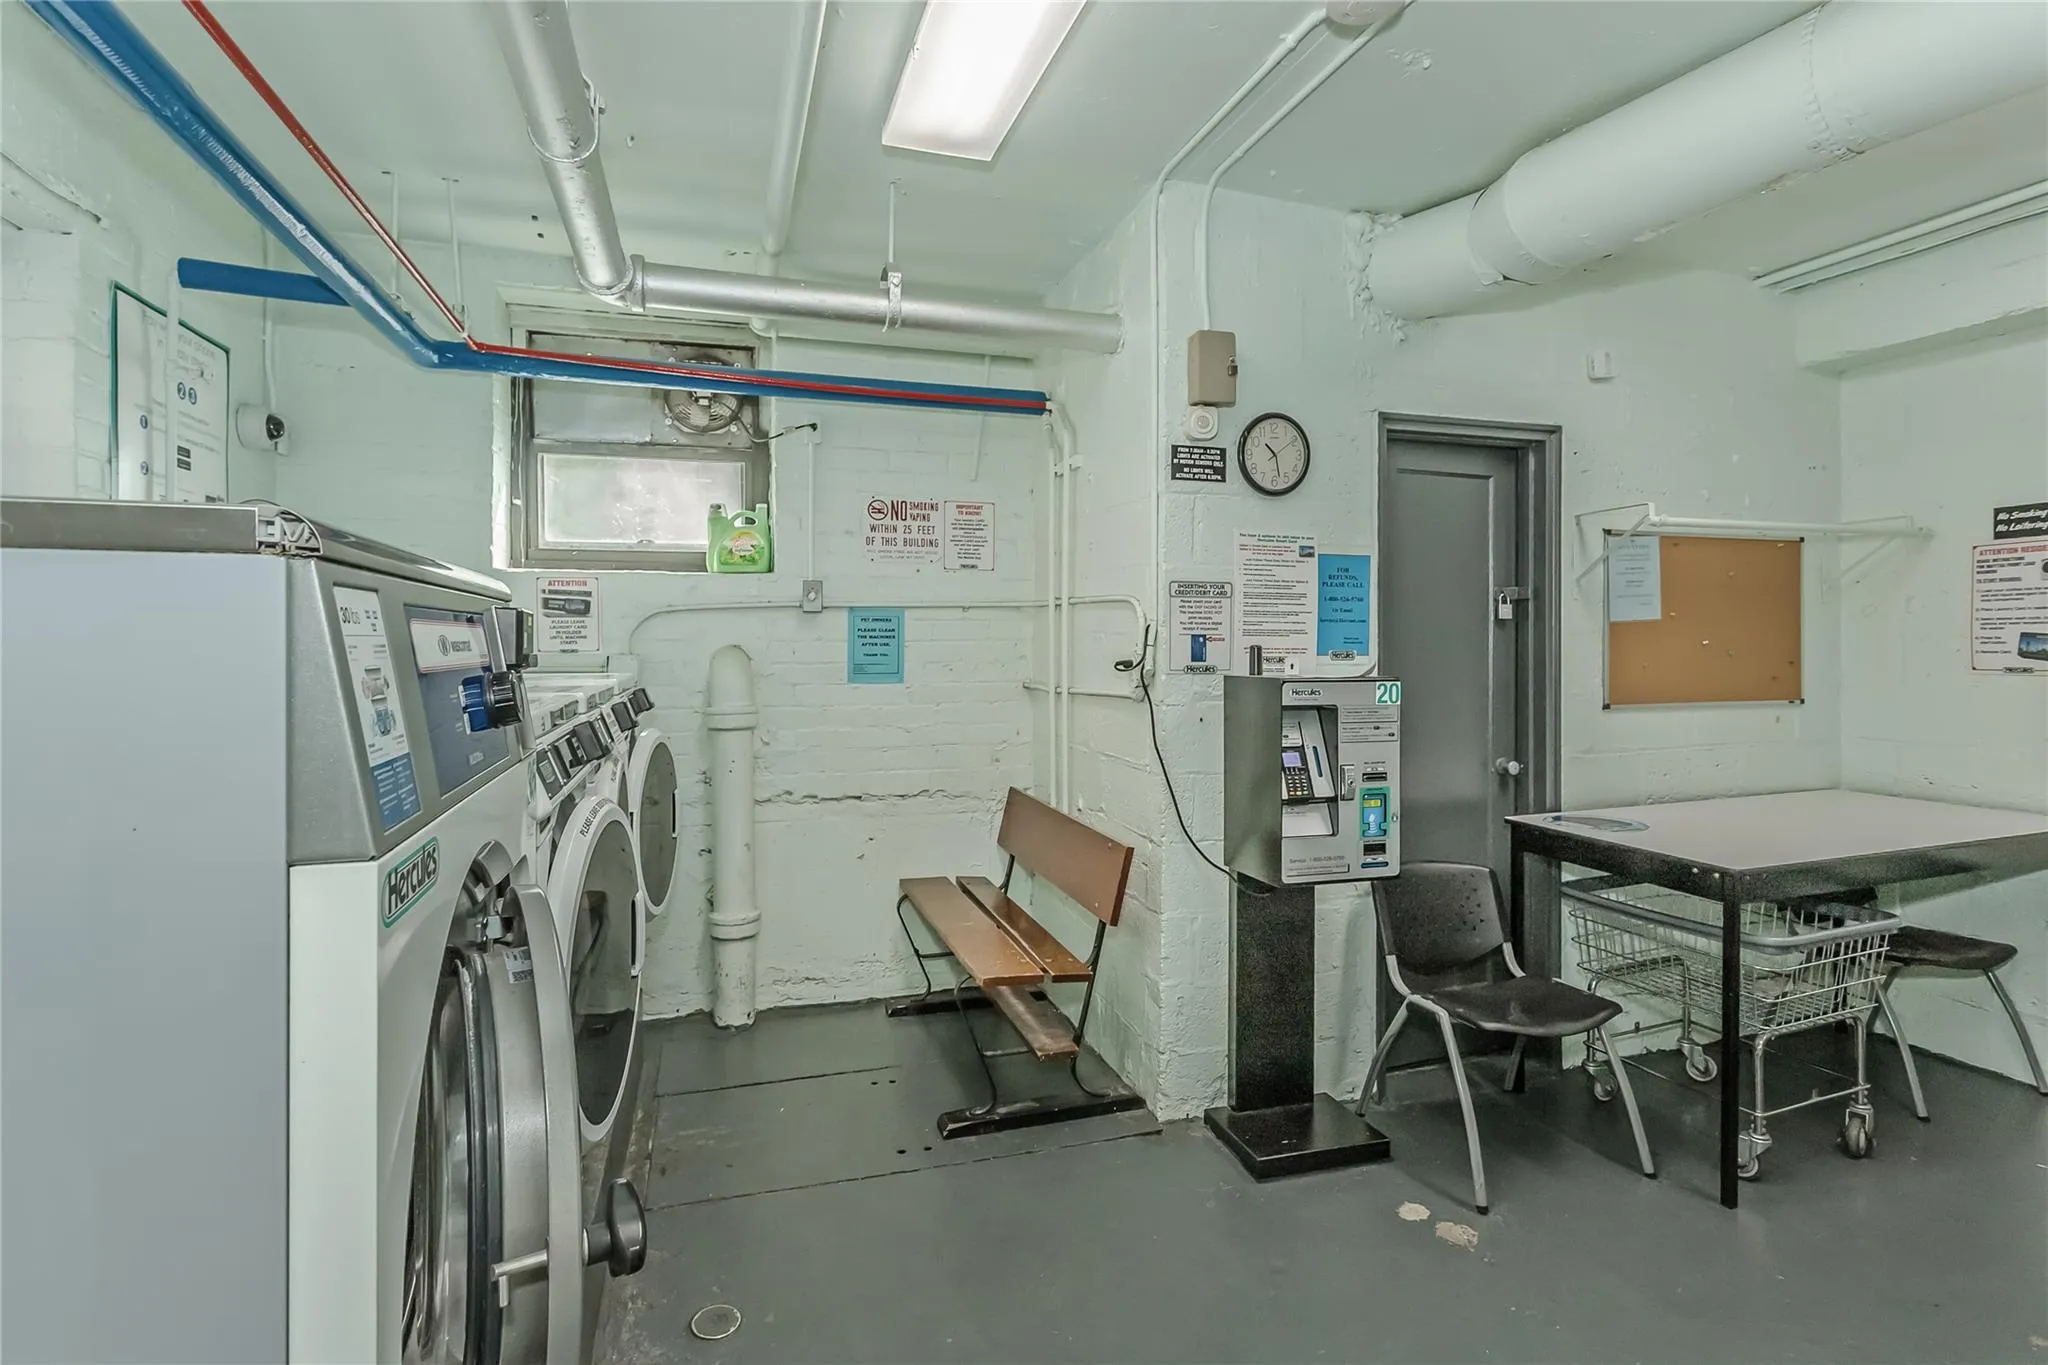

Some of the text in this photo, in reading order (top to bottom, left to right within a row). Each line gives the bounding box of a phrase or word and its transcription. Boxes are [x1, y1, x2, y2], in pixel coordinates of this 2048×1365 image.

[1259, 427, 1265, 437] 11
[1269, 422, 1278, 434] 12
[1250, 436, 1260, 448] 10
[1246, 448, 1253, 460] 9
[1296, 449, 1302, 461] 3
[1251, 463, 1257, 475] 8
[1292, 464, 1298, 473] 4
[1260, 472, 1265, 481] 7
[1271, 476, 1278, 488] 6
[1284, 472, 1289, 484] 5
[891, 500, 939, 521] NO SMOKING
[910, 513, 930, 522] VAPING
[869, 524, 935, 535] WITHIN 25 FEET
[1995, 524, 2008, 532] No
[865, 536, 939, 548] OF THIS BUILDING
[340, 606, 350, 623] 30
[1377, 683, 1400, 704] 20
[580, 817, 593, 837] PLEASE
[387, 844, 437, 915] Hercules
